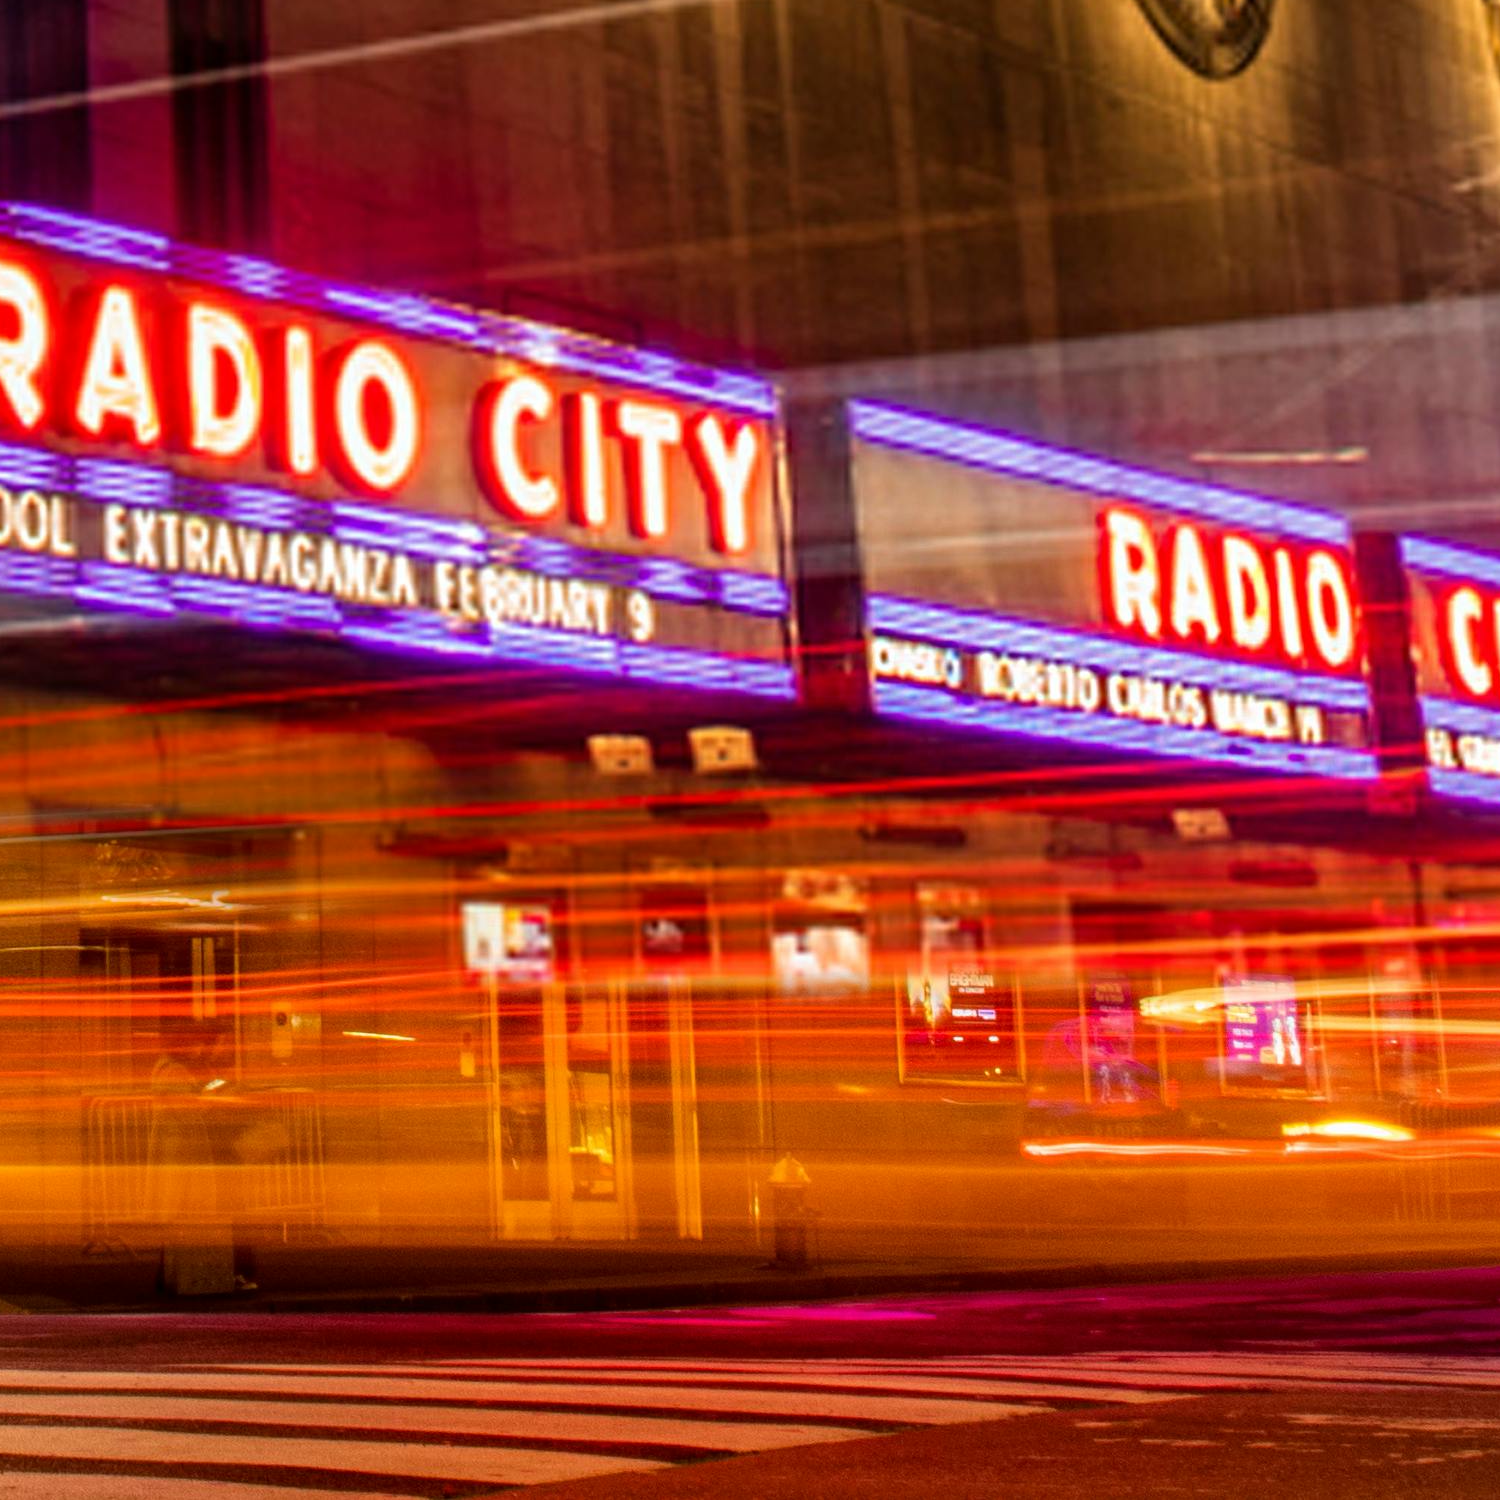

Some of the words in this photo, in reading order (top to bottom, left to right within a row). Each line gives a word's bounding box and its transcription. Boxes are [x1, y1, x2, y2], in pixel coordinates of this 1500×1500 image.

[487, 374, 757, 556] CITY
[103, 501, 419, 607] EXTRAVAGANZA
[436, 561, 610, 638] FEBRUARY
[628, 591, 656, 642] 9
[1106, 507, 1354, 668] RADIO
